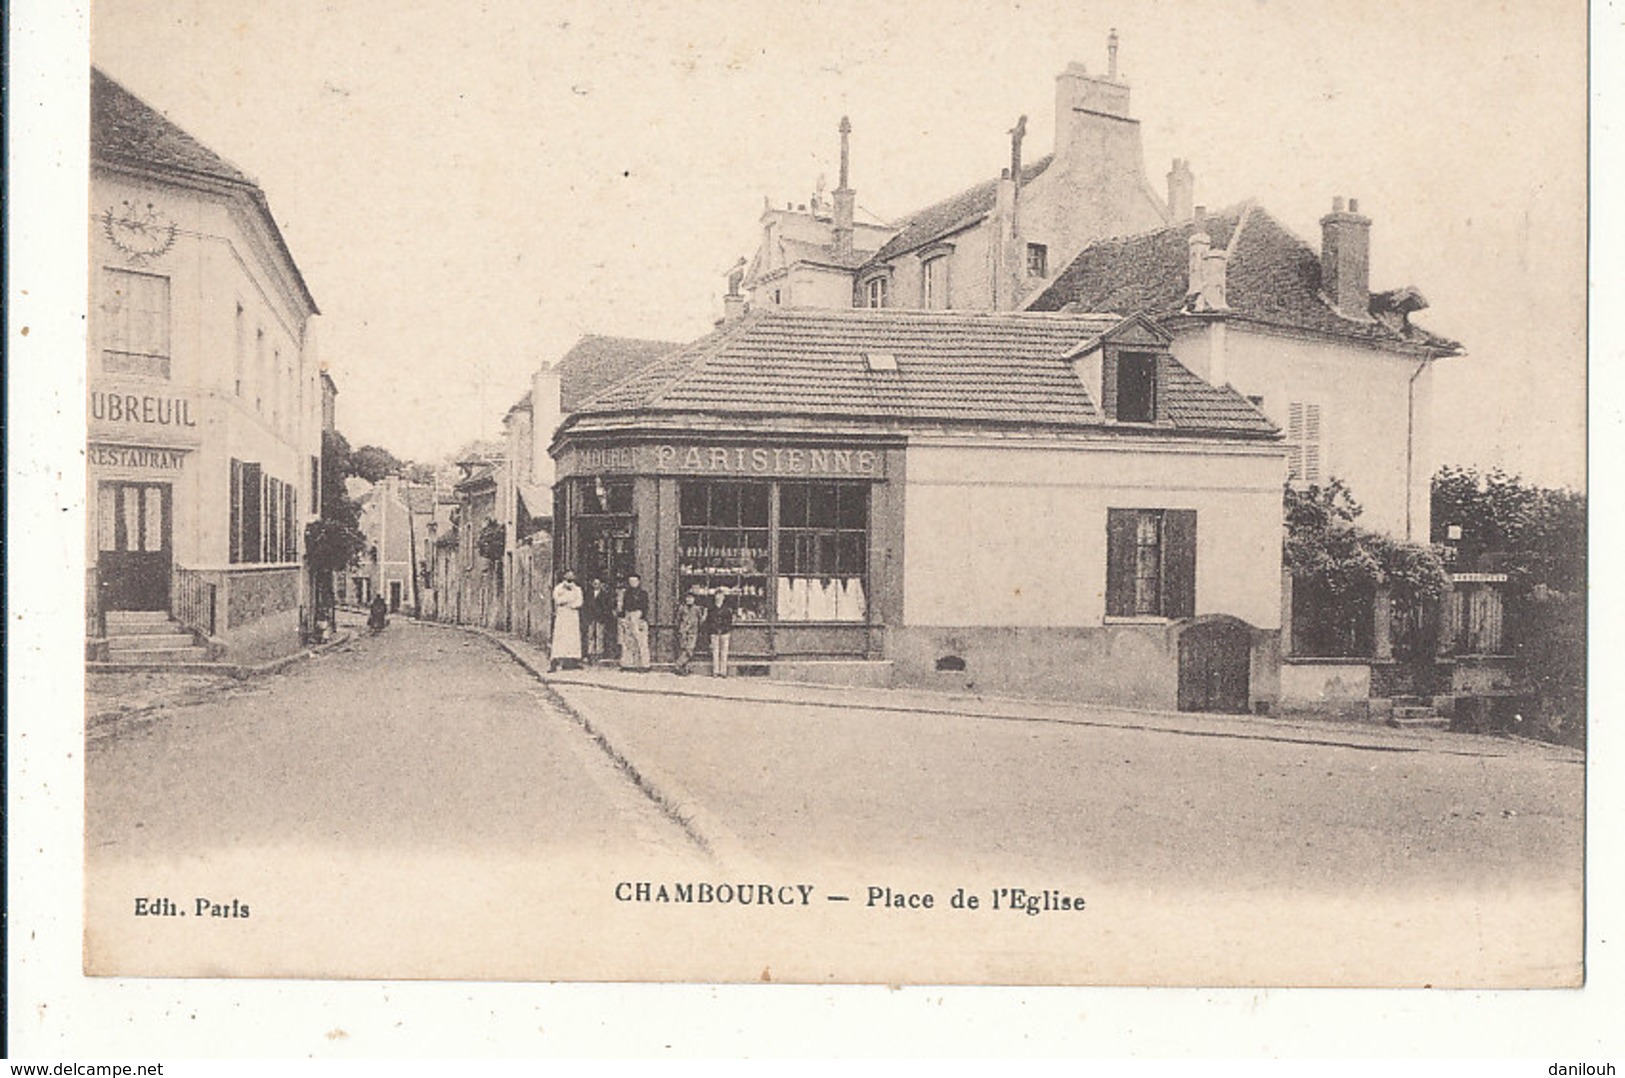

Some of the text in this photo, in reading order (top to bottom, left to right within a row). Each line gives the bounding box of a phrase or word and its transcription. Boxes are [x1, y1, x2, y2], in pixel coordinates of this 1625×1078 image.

[91, 392, 196, 427] UBREUIL
[88, 448, 185, 470] RESTAURANT
[656, 444, 878, 474] PARISIENNE
[195, 898, 250, 919] Paris
[615, 882, 814, 906] CHAMBOURCY
[866, 886, 934, 909] Place
[950, 888, 979, 910] de
[992, 888, 1086, 916] l'Eglise
